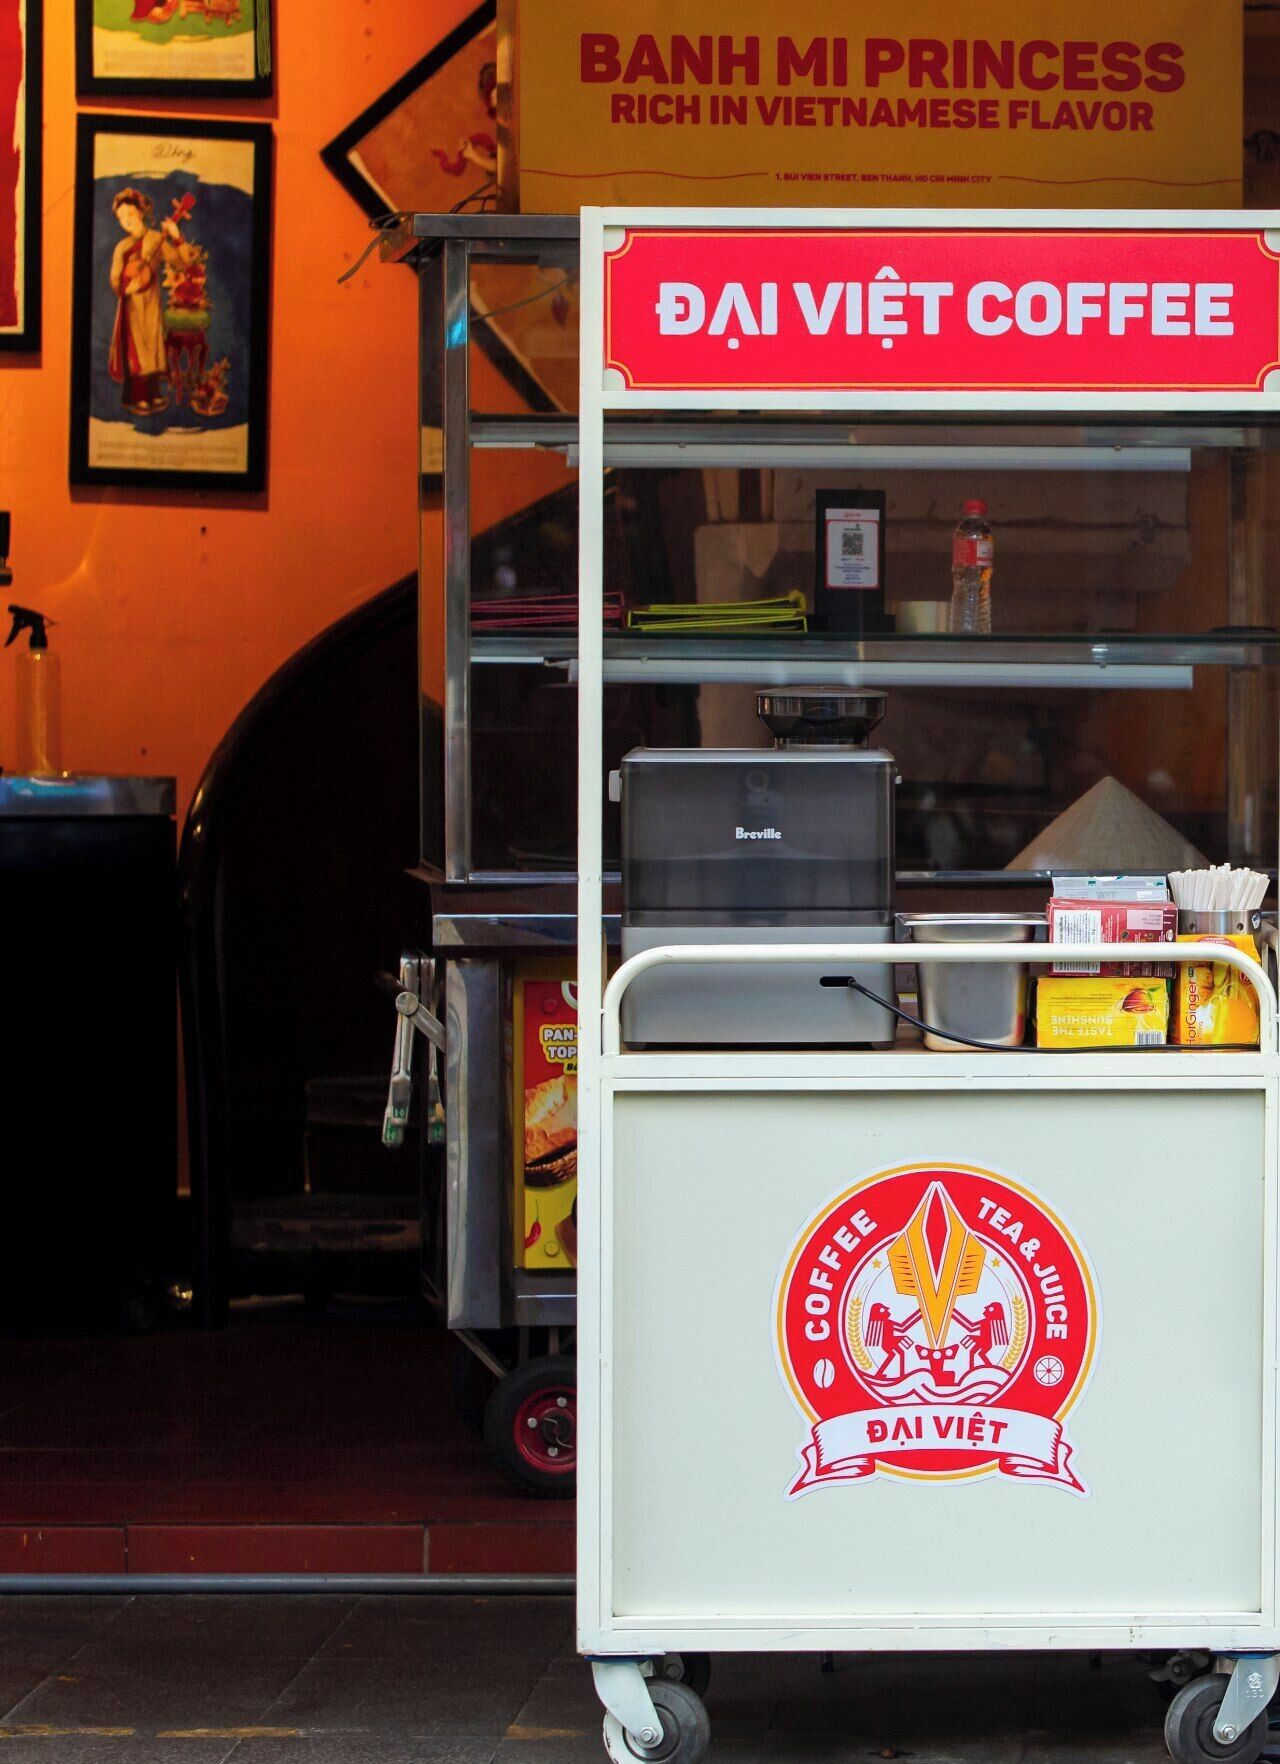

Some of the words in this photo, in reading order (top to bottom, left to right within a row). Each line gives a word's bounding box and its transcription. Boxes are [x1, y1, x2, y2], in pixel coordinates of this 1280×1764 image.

[580, 32, 760, 86] BANH
[777, 36, 848, 87] MI
[865, 38, 1186, 93] PRINCESS
[611, 93, 701, 125] RICH
[709, 95, 748, 126] IN
[756, 96, 1000, 129] VIETNAMESE
[1008, 100, 1154, 132] FLAVOR
[784, 173, 799, 182] BUI
[800, 173, 822, 182] VIEN
[861, 174, 878, 182] BEN
[915, 175, 928, 183] HO
[930, 175, 945, 183] CHI
[947, 175, 969, 183] MINH
[971, 175, 992, 183] CITY
[655, 282, 777, 349] ĐẠI
[793, 266, 953, 349] VIỆT
[967, 281, 1233, 336] COFFEE
[735, 827, 782, 840] Breville
[1050, 1014, 1113, 1025] SUNSHINE
[1052, 1025, 1072, 1036] THE
[1078, 1025, 1113, 1036] TASTE
[805, 1208, 878, 1342] COFFEE
[978, 1197, 1025, 1244] TEA
[1019, 1238, 1041, 1263] &
[1033, 1261, 1069, 1340] JUICE
[867, 1419, 923, 1447] ĐẠI
[932, 1411, 1008, 1447] VIỆT
